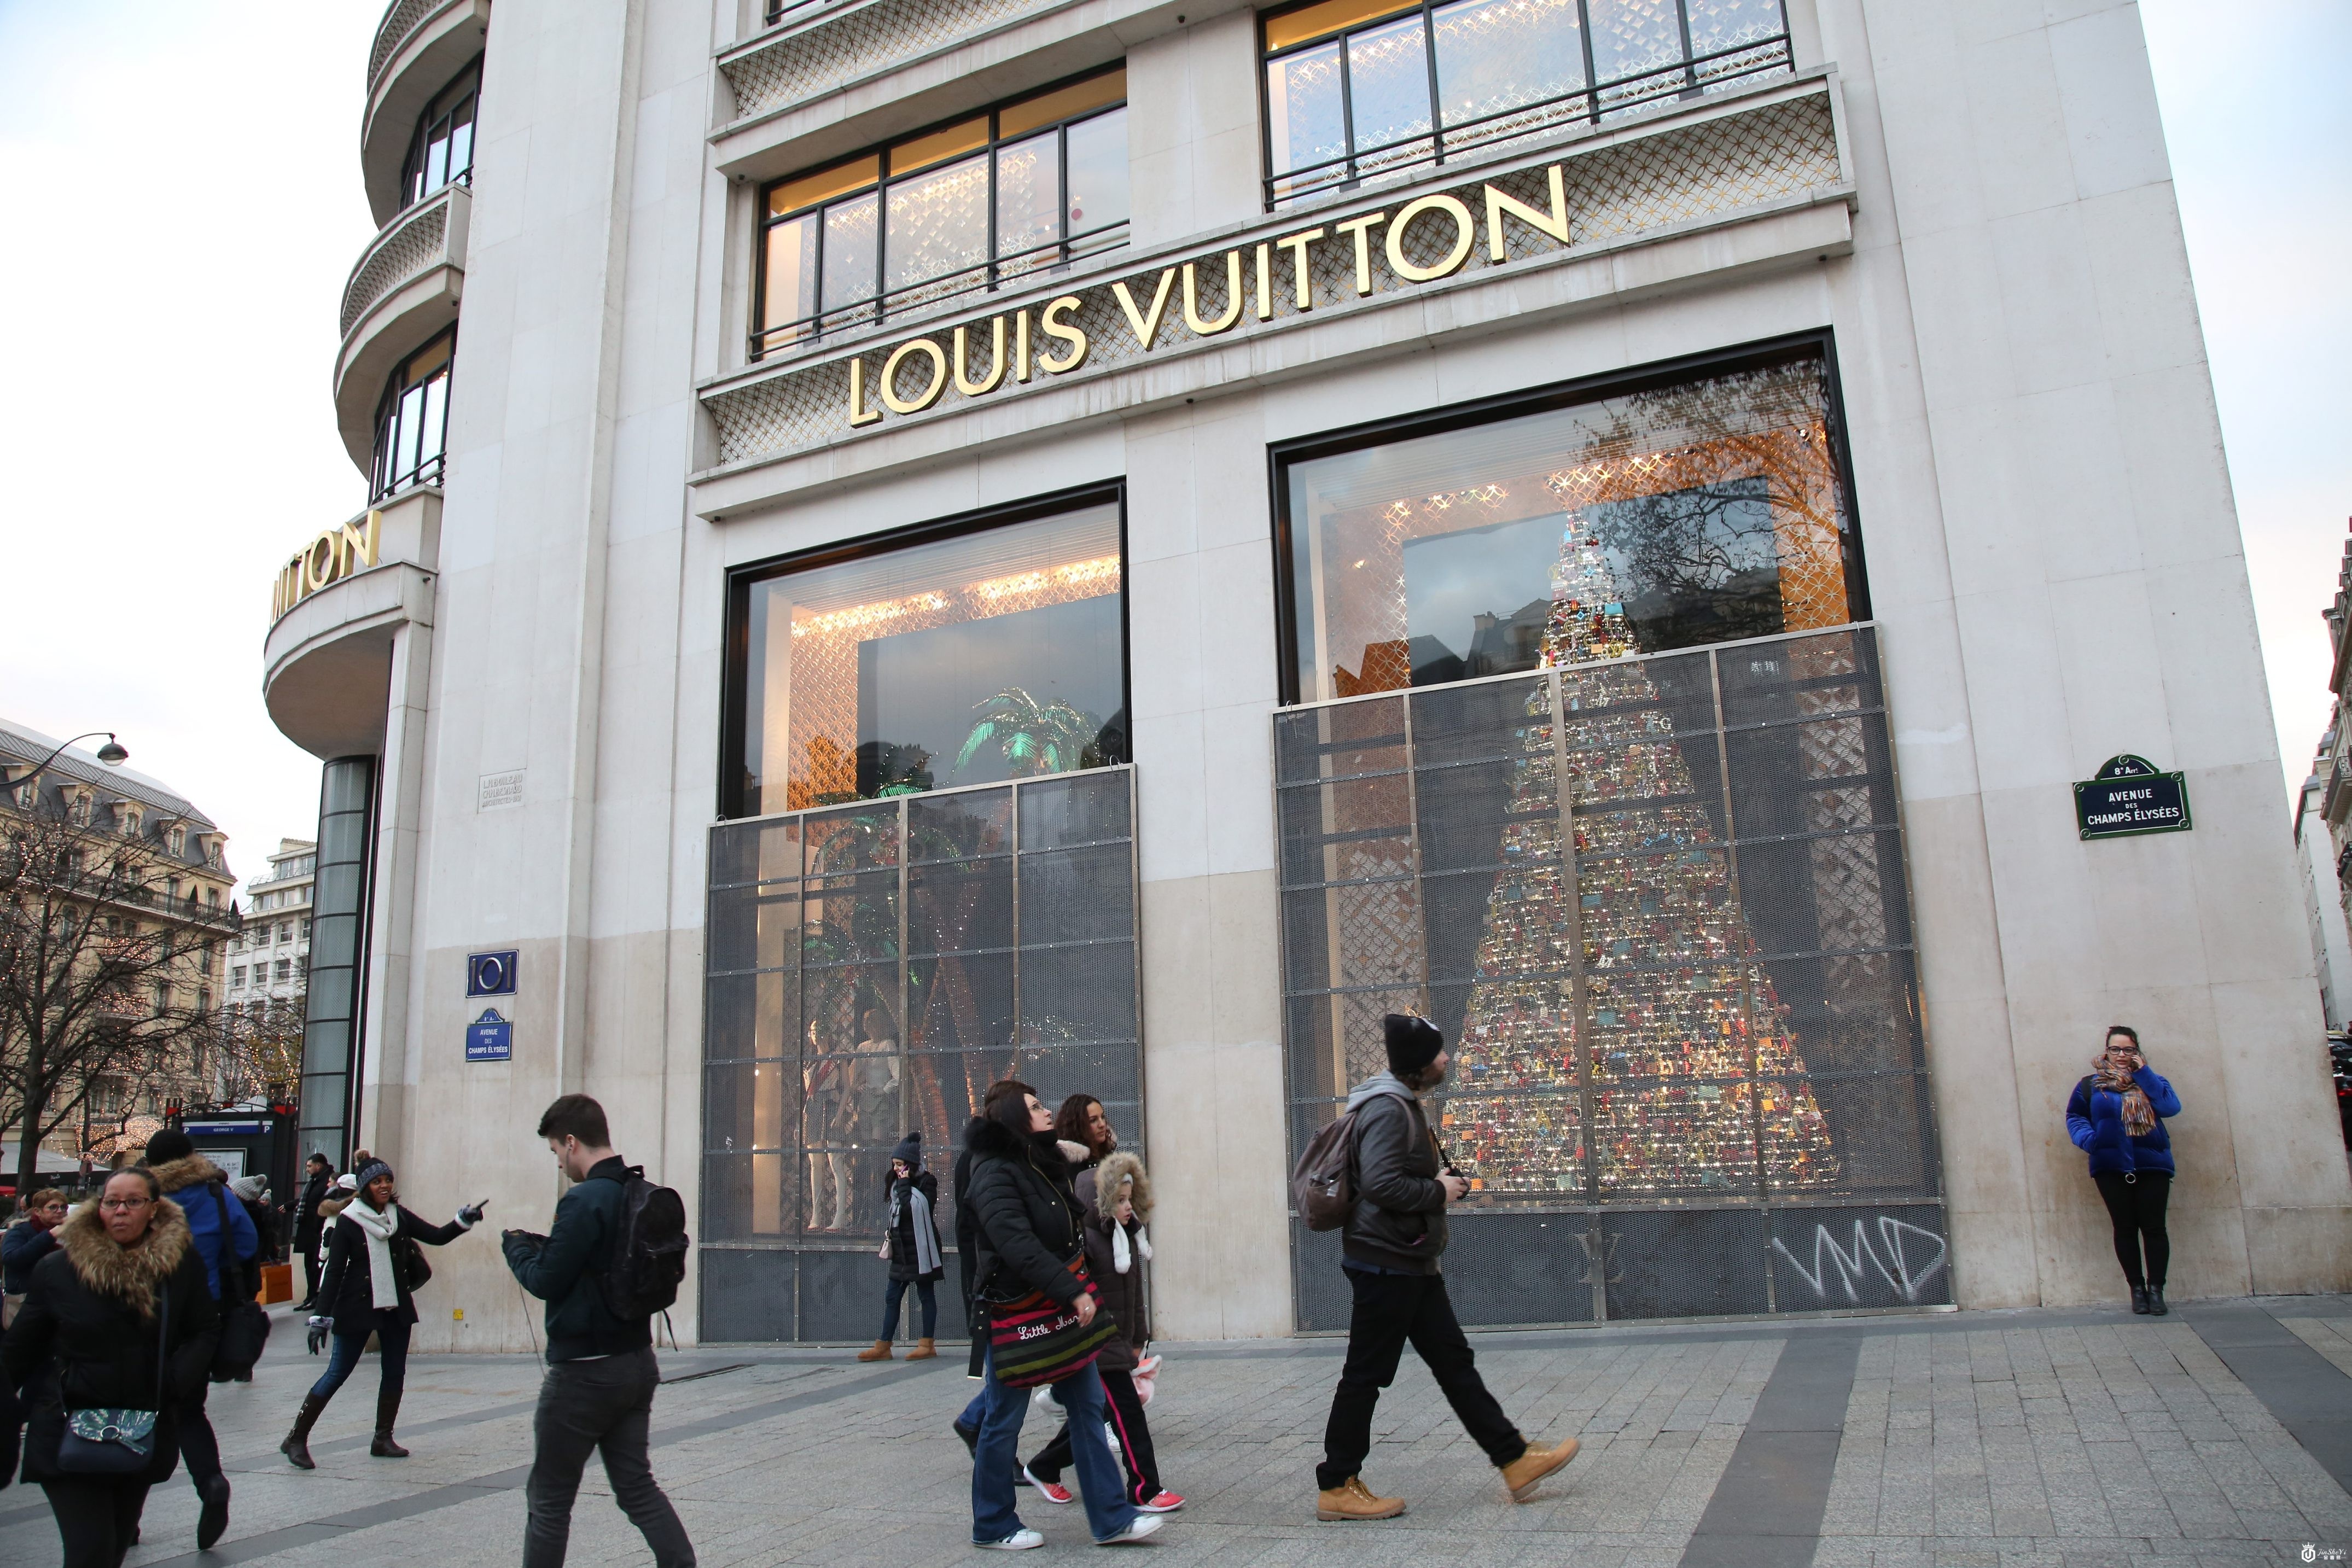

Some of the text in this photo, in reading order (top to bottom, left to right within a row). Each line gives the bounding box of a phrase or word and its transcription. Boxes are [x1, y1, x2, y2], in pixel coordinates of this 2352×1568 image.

[851, 165, 1570, 429] LOUIS VUITTON
[2109, 788, 2152, 802] AVENUE
[2087, 807, 2179, 825] CHAMPS ÉLYSÉES
[470, 955, 512, 992] 101
[488, 1045, 508, 1053] ÉLYSÉES
[1017, 1324, 1051, 1340] Little
